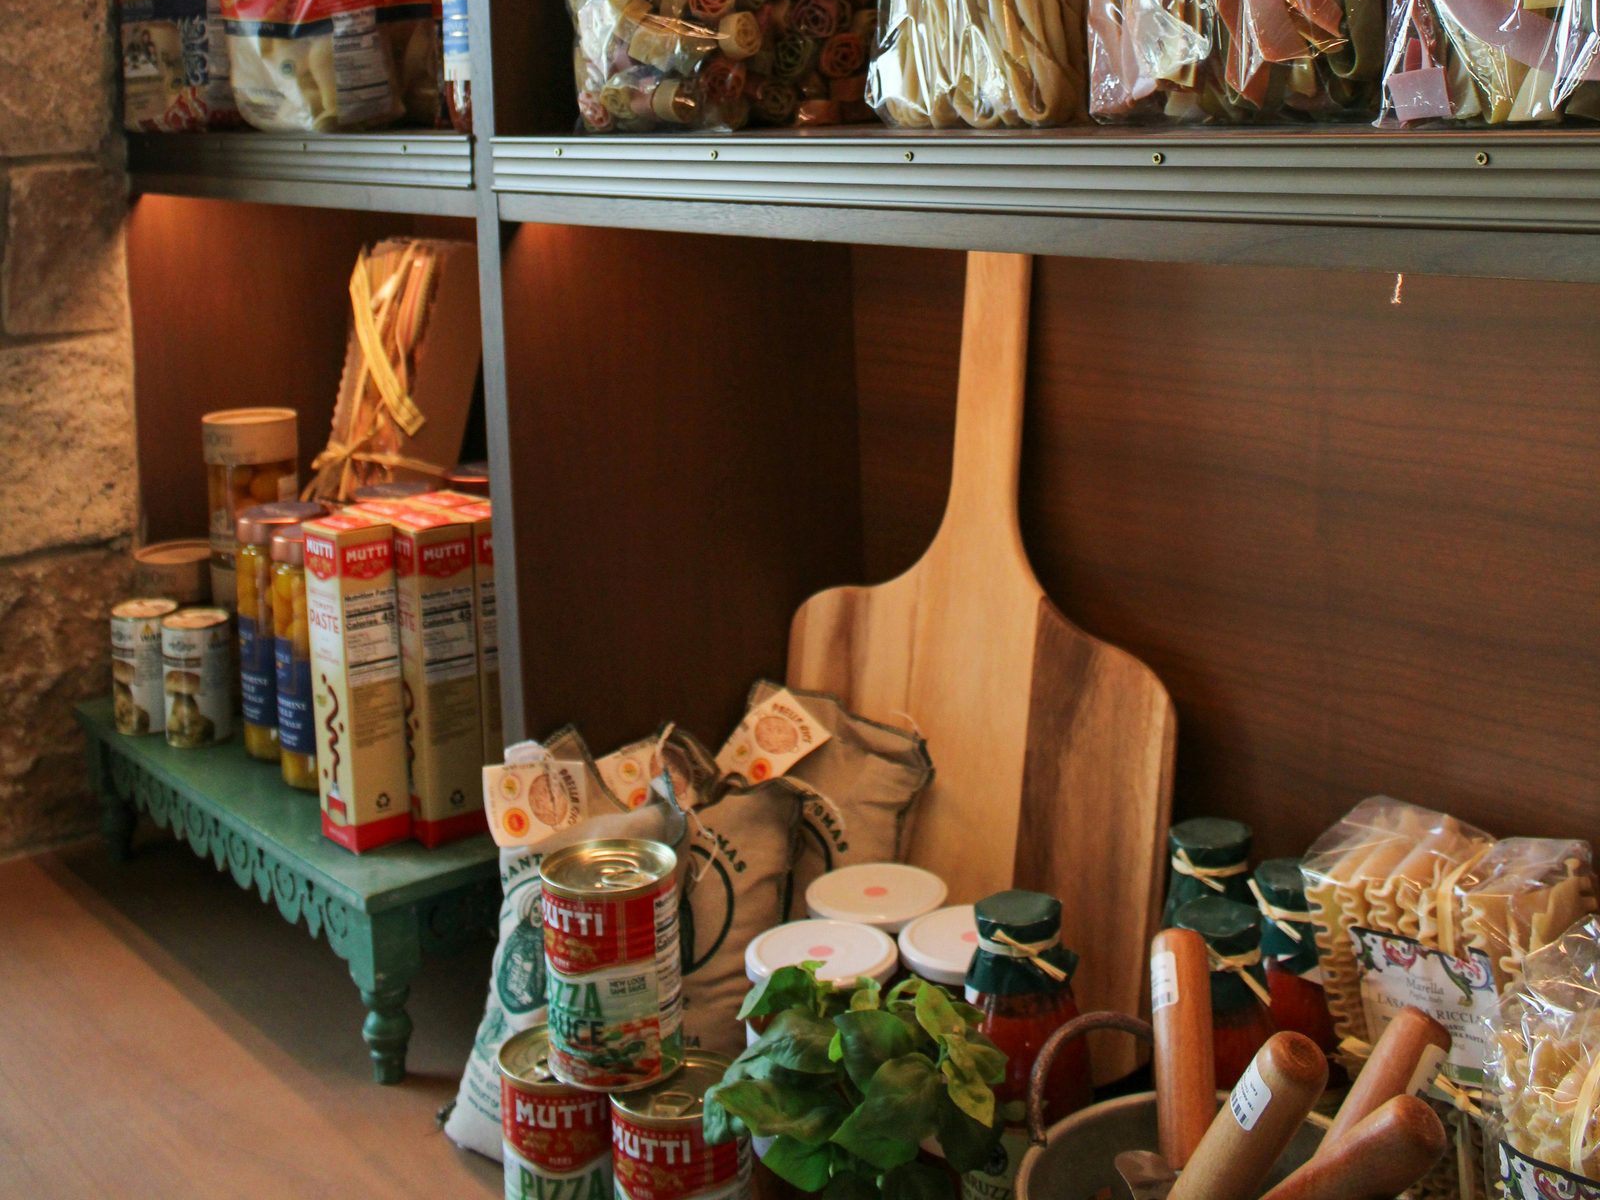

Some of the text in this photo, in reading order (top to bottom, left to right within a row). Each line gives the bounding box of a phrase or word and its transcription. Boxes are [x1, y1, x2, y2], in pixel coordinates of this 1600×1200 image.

[305, 536, 334, 561] MUTTI
[345, 542, 389, 564] MUTTI
[423, 542, 466, 562] MUTTI
[309, 608, 341, 634] PASTE
[345, 618, 379, 631] Calories
[609, 975, 647, 988] NEW LOOK
[609, 987, 627, 996] SAME
[1407, 977, 1445, 996] Marella
[549, 1007, 607, 1047] AUCE
[515, 1097, 606, 1129] MUTTI
[613, 1119, 692, 1165] MUTTI
[519, 1164, 603, 1200] PIZZA
